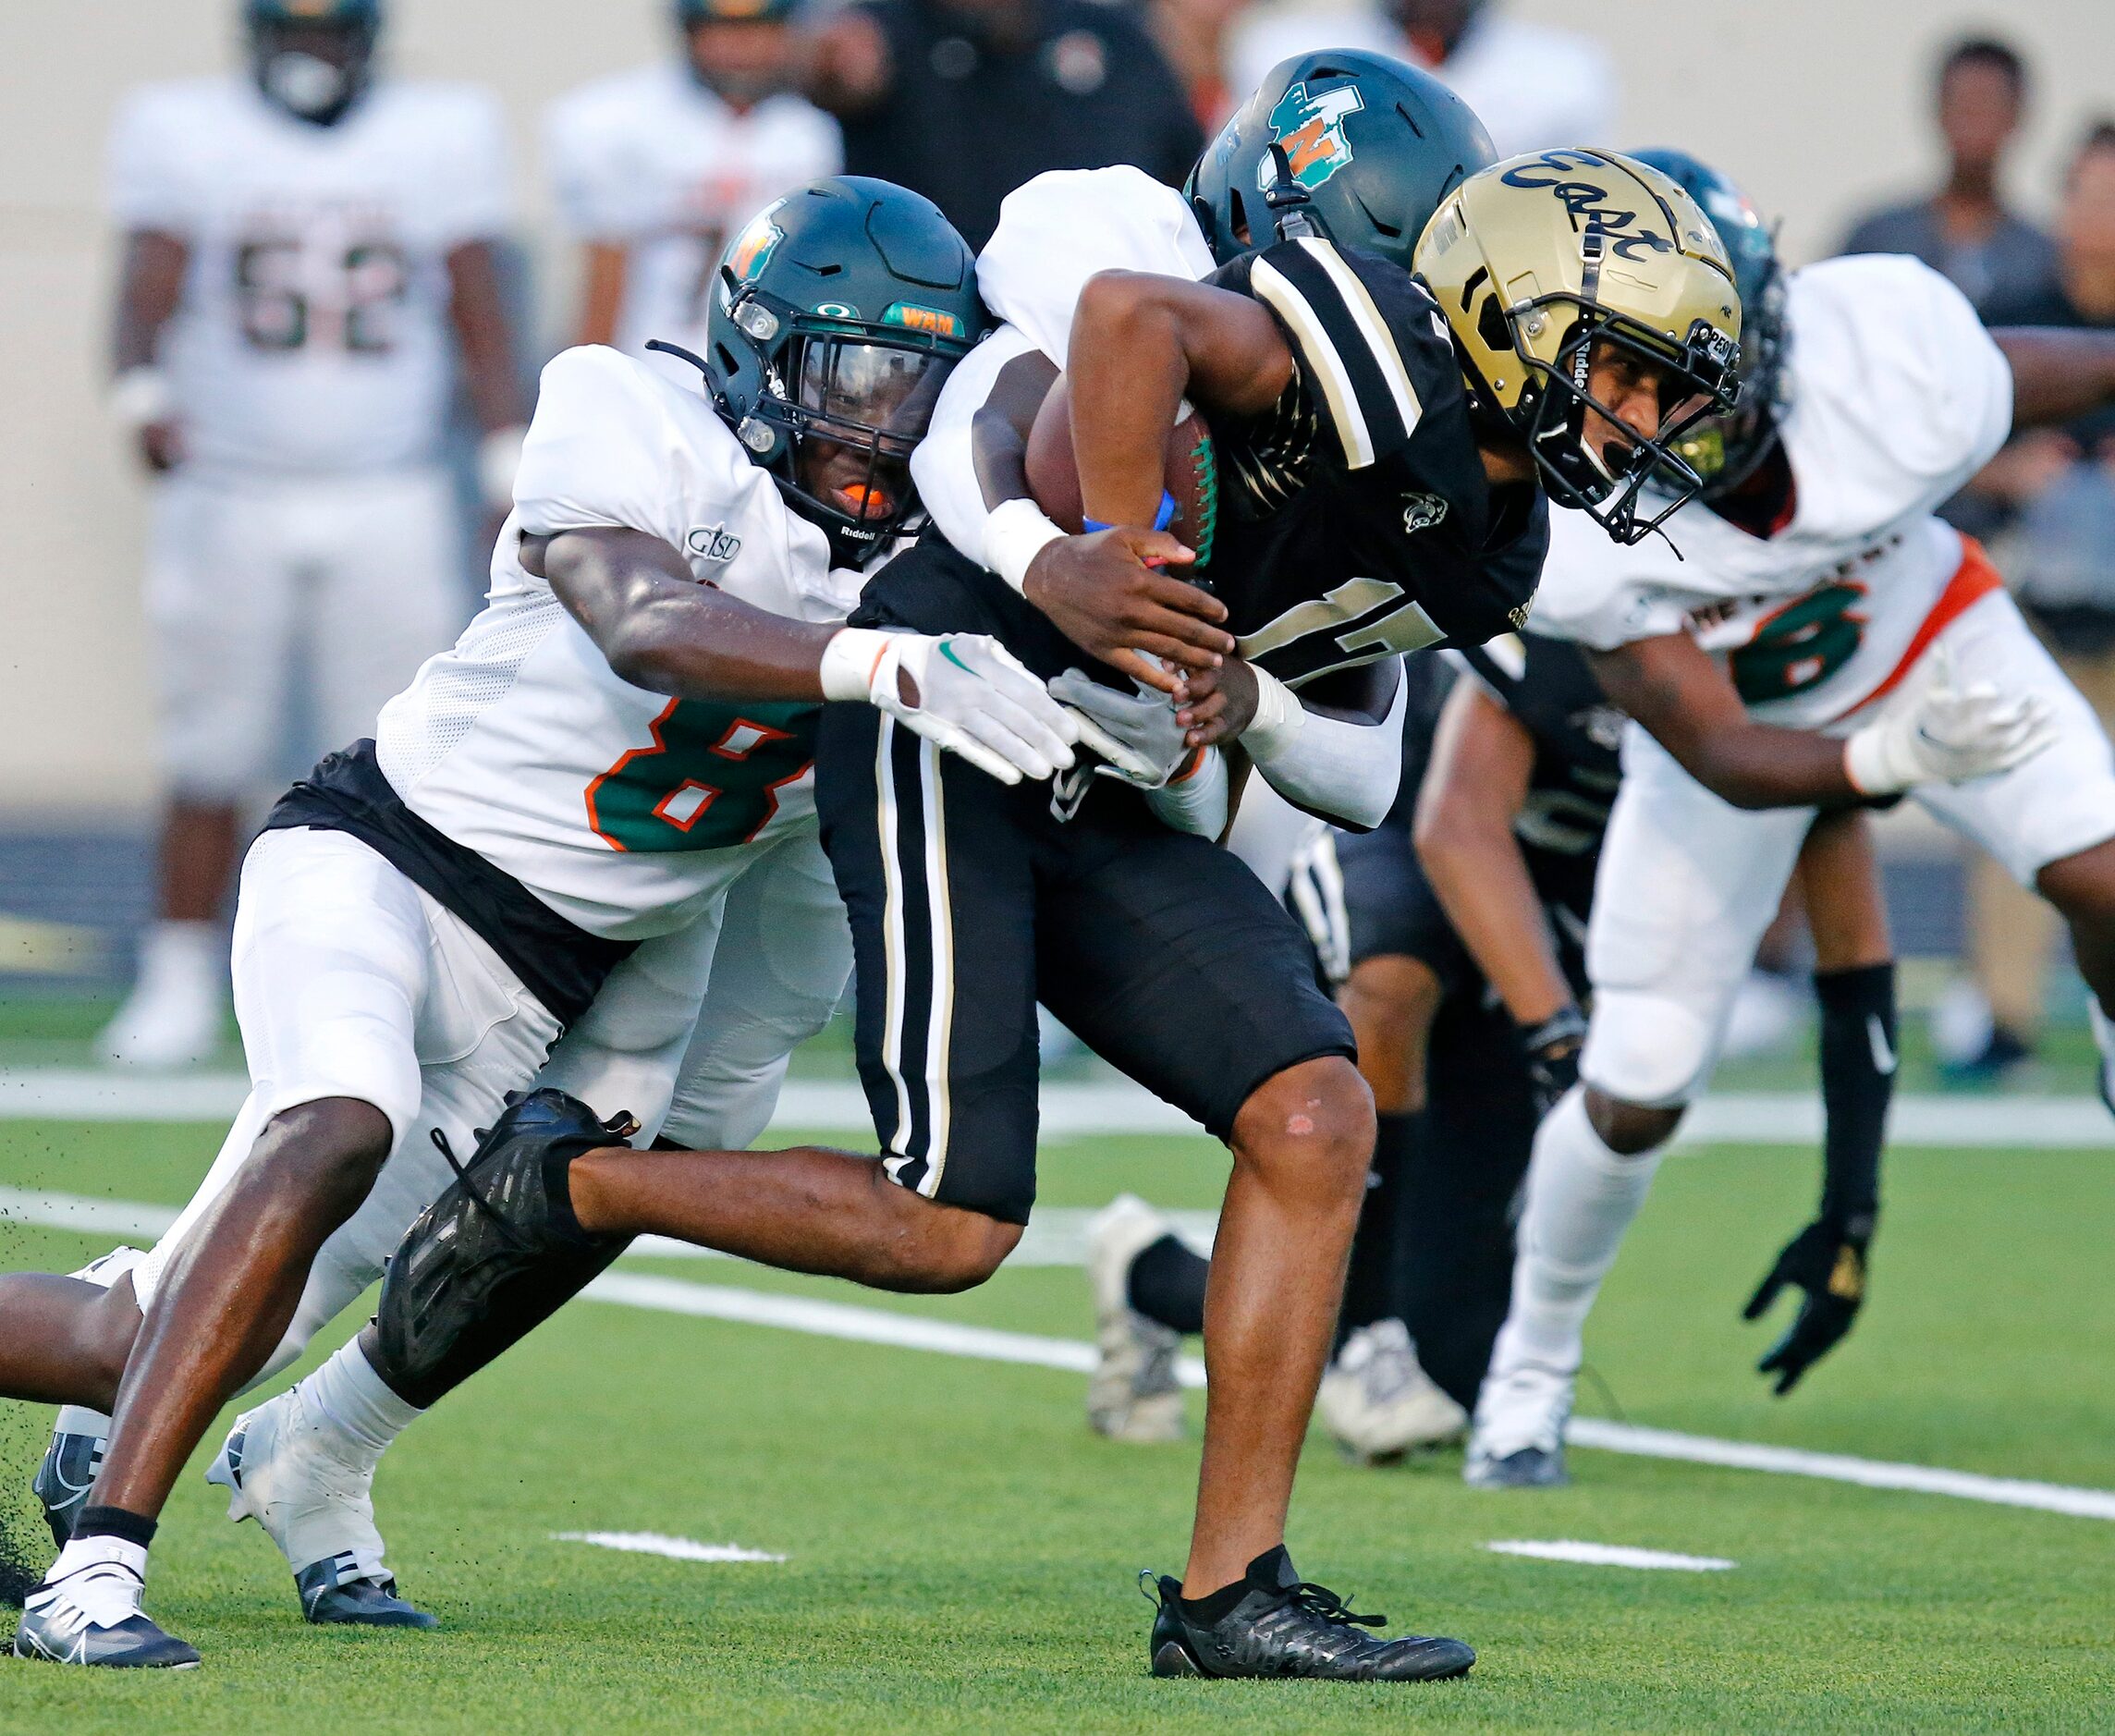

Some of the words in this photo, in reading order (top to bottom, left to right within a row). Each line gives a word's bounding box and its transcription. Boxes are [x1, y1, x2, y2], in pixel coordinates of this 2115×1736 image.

[234, 238, 409, 353] 52
[840, 526, 875, 541] Riddell
[584, 696, 821, 852] 8
